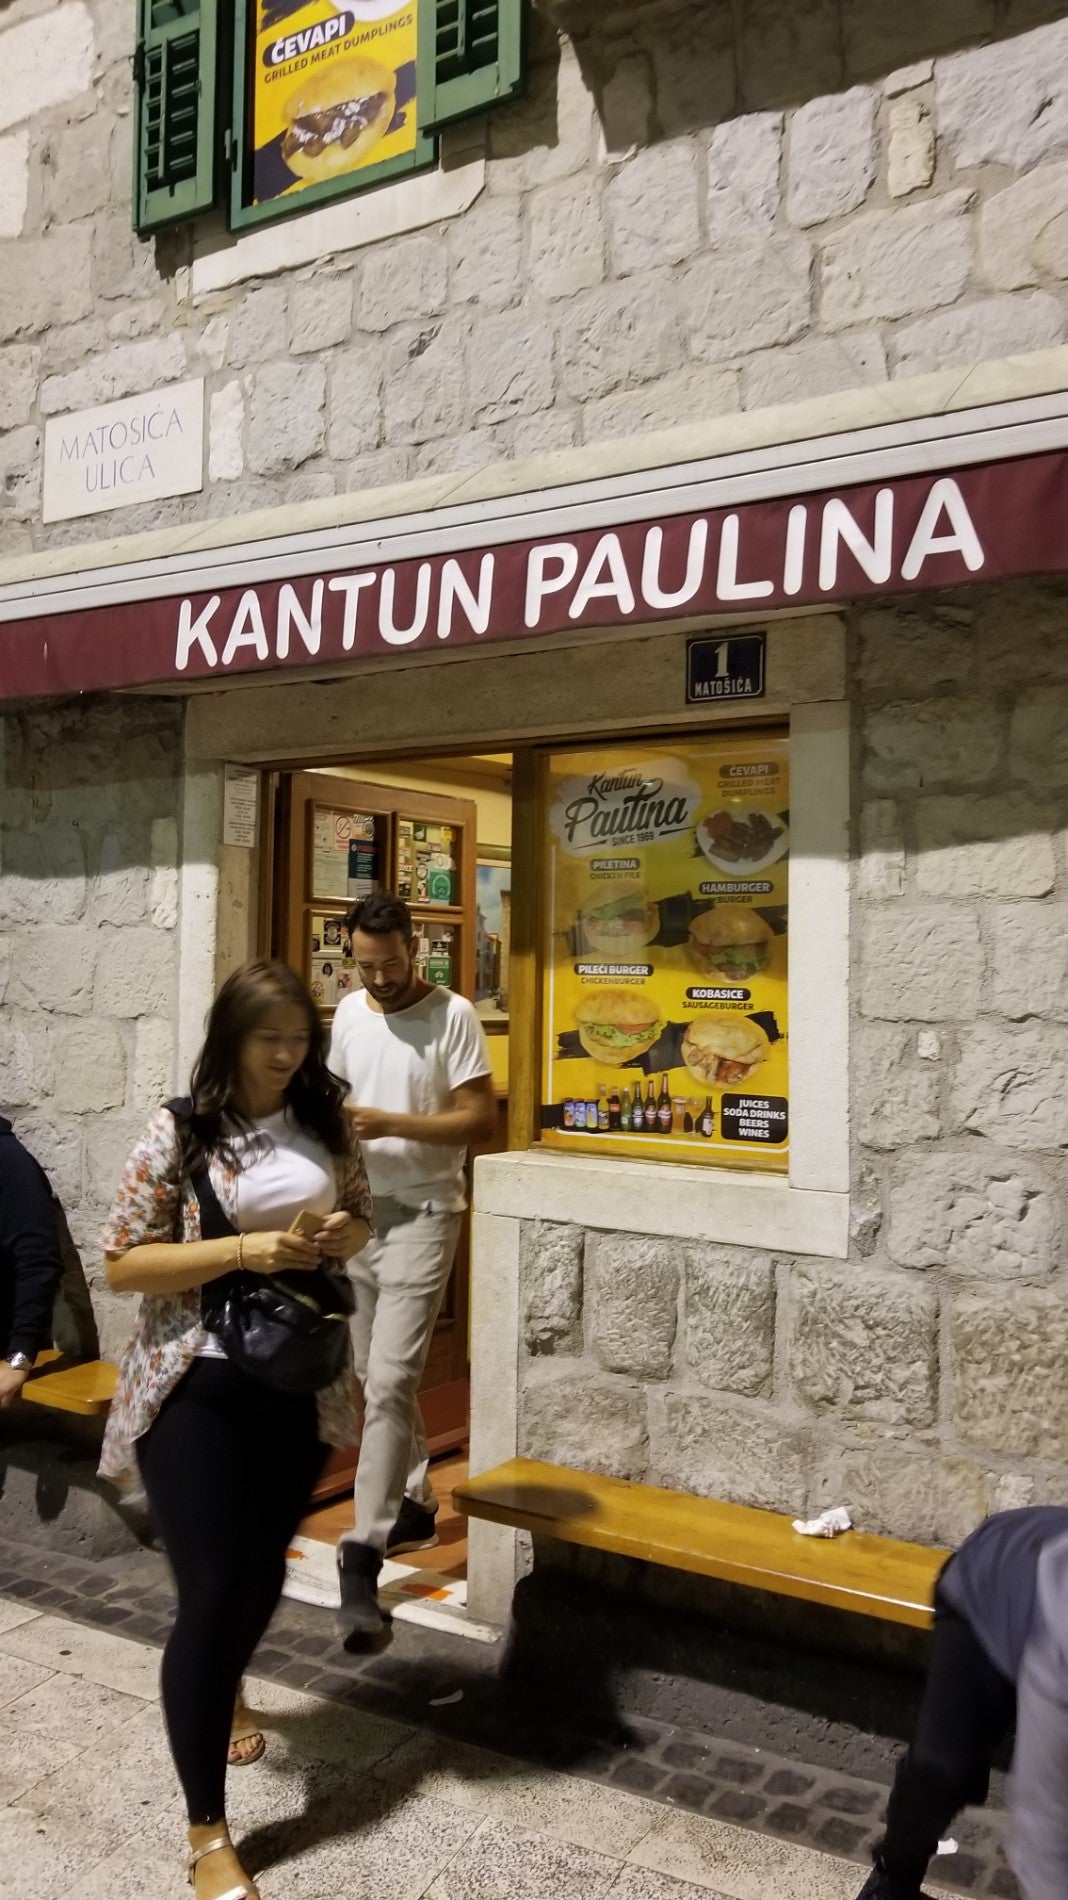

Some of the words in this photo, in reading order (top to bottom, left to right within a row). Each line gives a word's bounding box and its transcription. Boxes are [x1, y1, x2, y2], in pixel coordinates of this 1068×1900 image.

[264, 59, 308, 84] GRILLED
[311, 44, 341, 64] MEAT
[344, 14, 413, 50] DUMPLINGS
[86, 453, 155, 492] ULICA
[175, 552, 495, 671] KANTUN
[524, 477, 985, 628] PAULINA
[714, 641, 730, 678] 1
[694, 676, 752, 697] MATOŠIĆA
[586, 768, 643, 801] Kantun
[592, 859, 638, 870] PILETINA
[701, 882, 770, 893] HAMBURGER
[717, 895, 753, 904] BURGER
[608, 965, 649, 975] BURGER
[692, 988, 744, 999] KOBASICE
[682, 1001, 754, 1011] SAUSAGEBURGER
[739, 1099, 770, 1109] JUICES
[723, 1107, 749, 1117] SODA
[749, 1109, 786, 1120] DRINKS
[739, 1118, 769, 1128] BEERS
[738, 1128, 770, 1138] WINES
